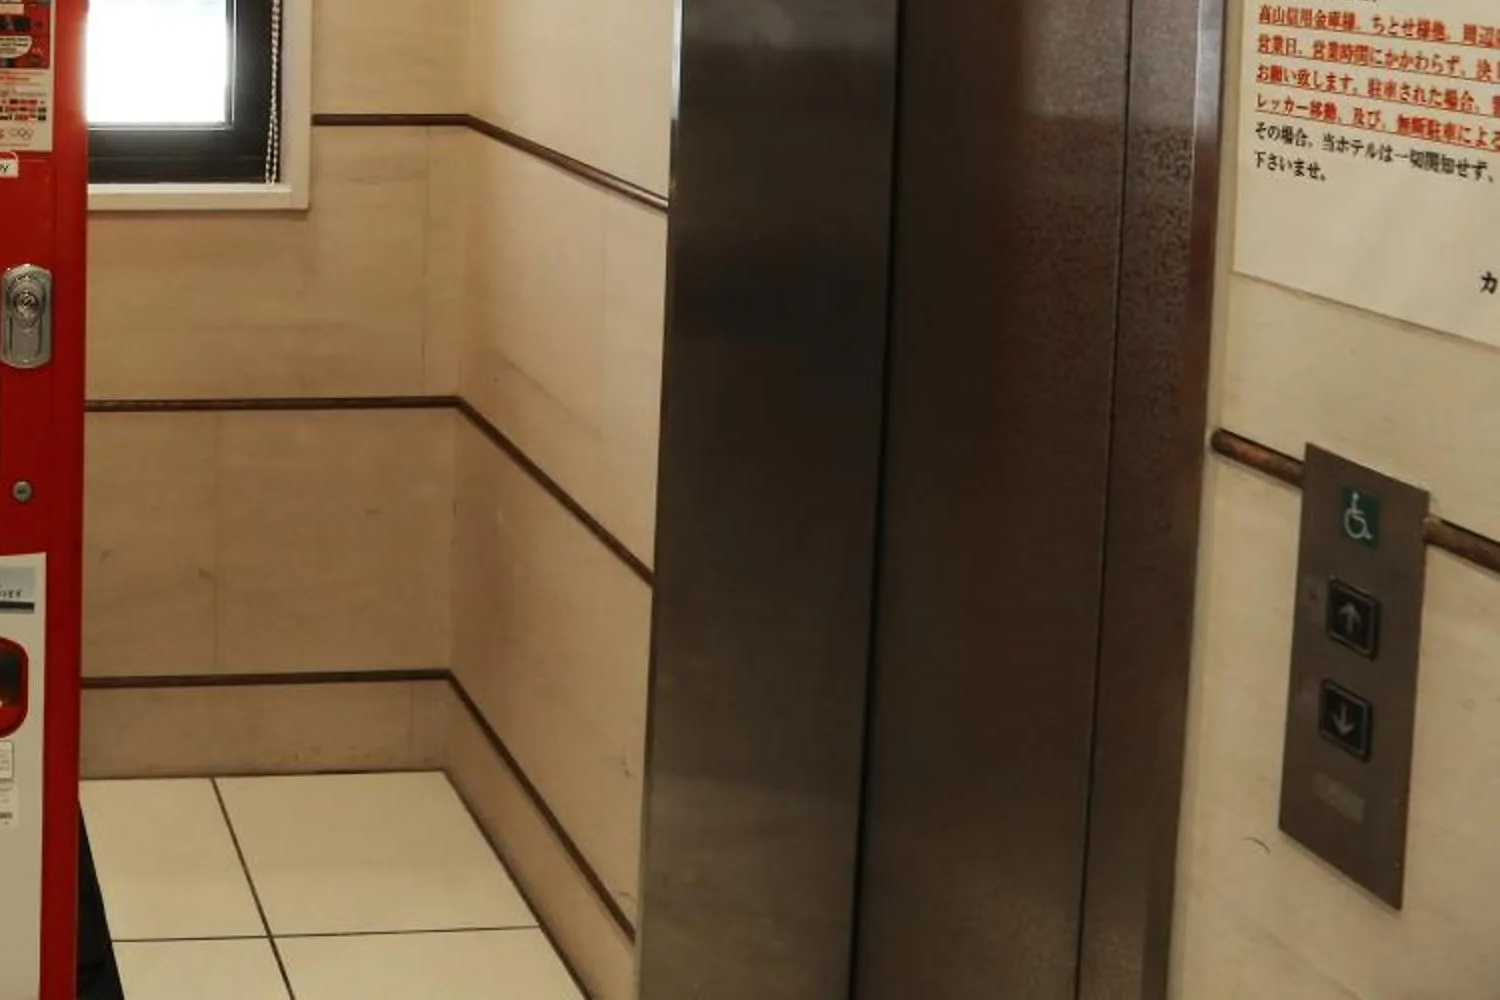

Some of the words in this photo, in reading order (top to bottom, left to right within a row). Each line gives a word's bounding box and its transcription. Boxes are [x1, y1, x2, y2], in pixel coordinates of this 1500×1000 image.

[1254, 151, 1327, 181] 下さいませ。
[1480, 272, 1498, 294] カ
